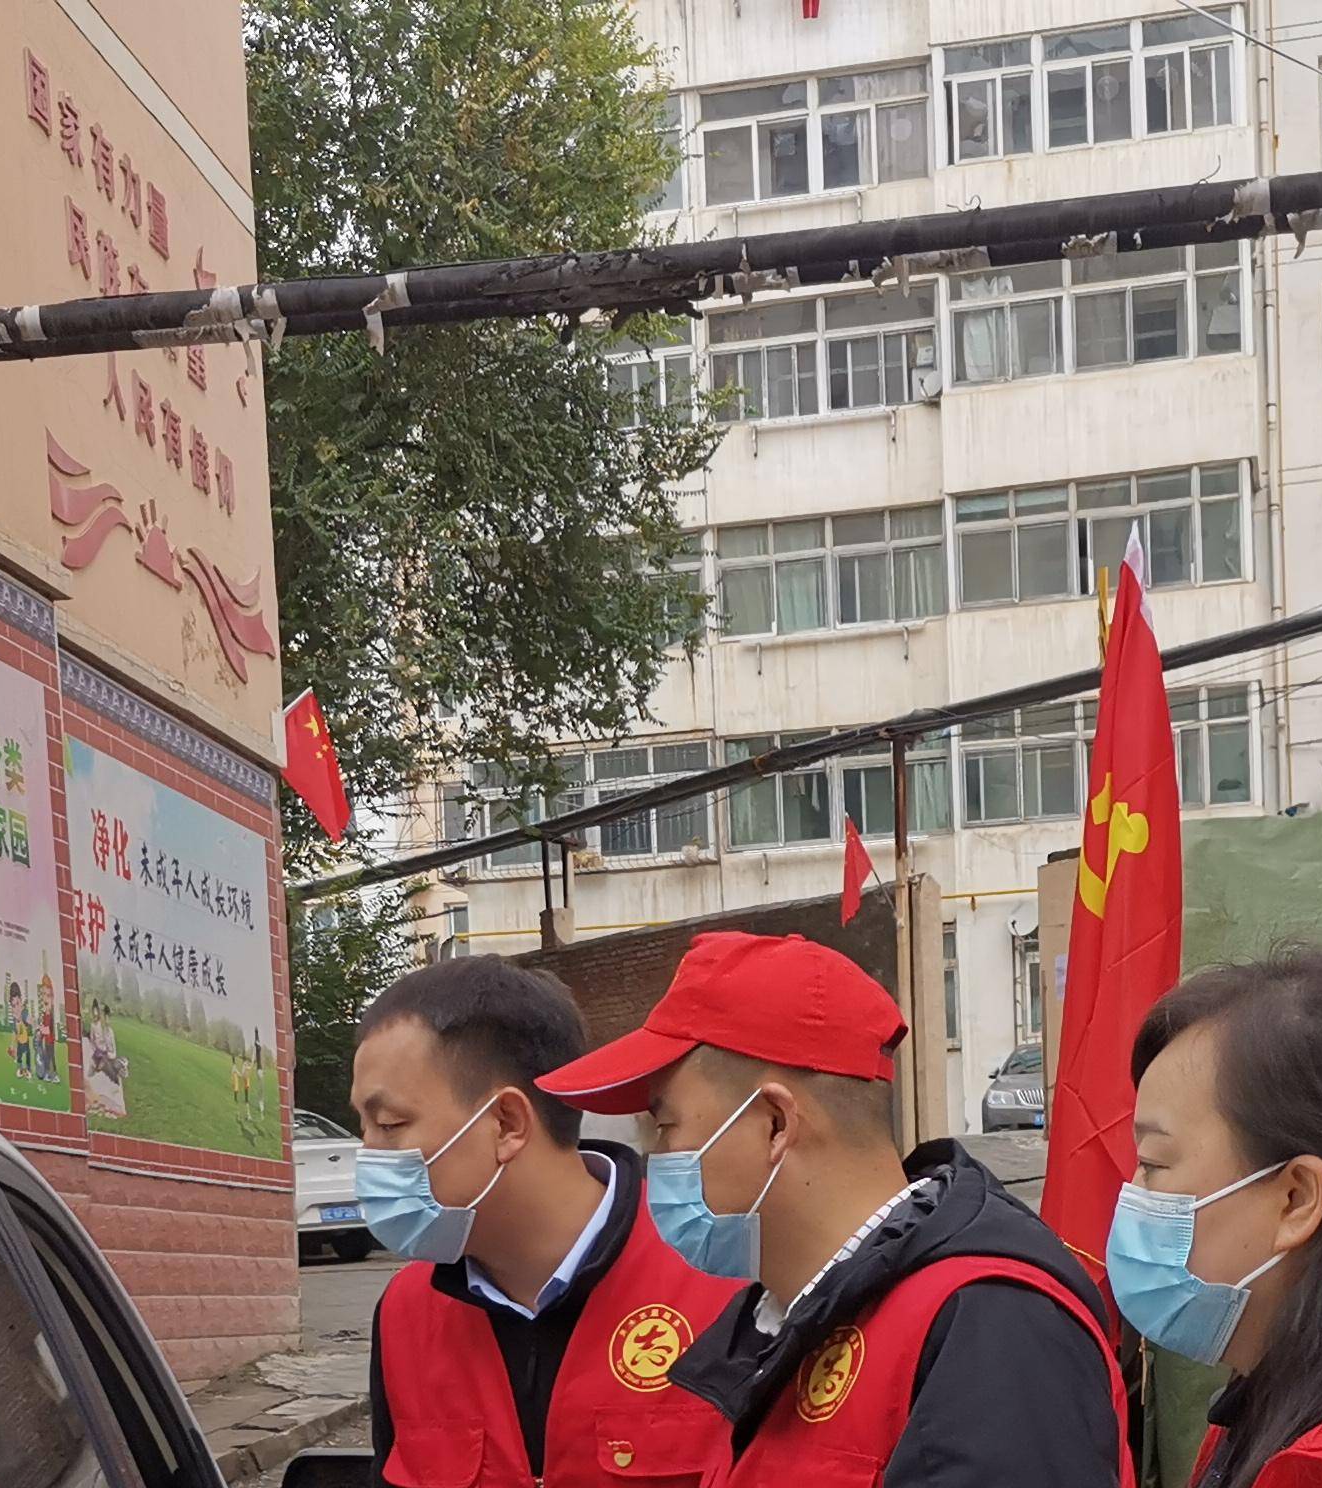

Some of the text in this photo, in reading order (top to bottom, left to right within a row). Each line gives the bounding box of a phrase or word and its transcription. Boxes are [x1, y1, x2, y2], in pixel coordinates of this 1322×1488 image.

[23, 46, 169, 261] 国家有力量
[102, 351, 235, 517] 人民有信仰
[91, 807, 255, 931] 净化 未成年人成长环境
[112, 917, 228, 997] 未成年人健康成长
